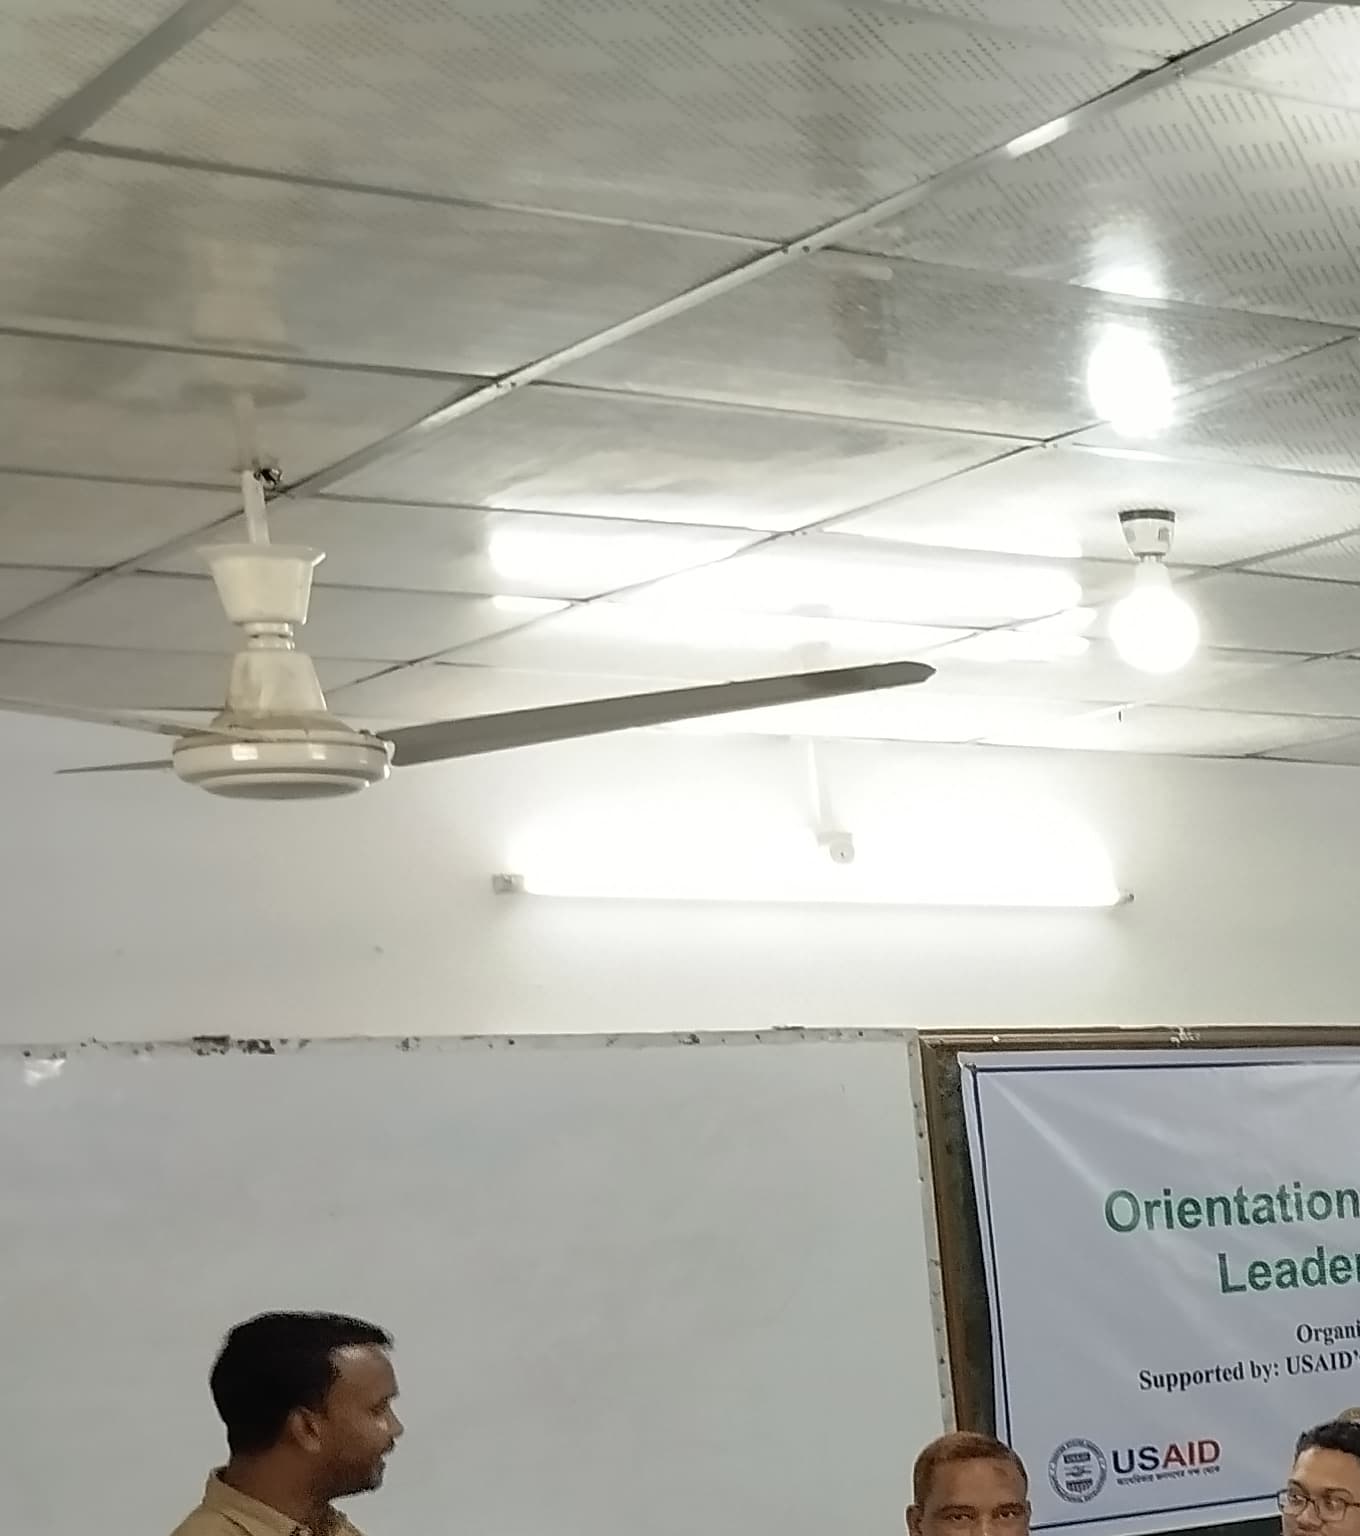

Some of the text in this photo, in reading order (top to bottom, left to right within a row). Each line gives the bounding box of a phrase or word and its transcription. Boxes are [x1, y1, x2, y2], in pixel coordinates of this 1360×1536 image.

[1104, 1181, 1360, 1233] Orientation
[1139, 1361, 1245, 1393] Supported
[1250, 1360, 1279, 1383] by:
[1112, 1439, 1221, 1474] USAID
